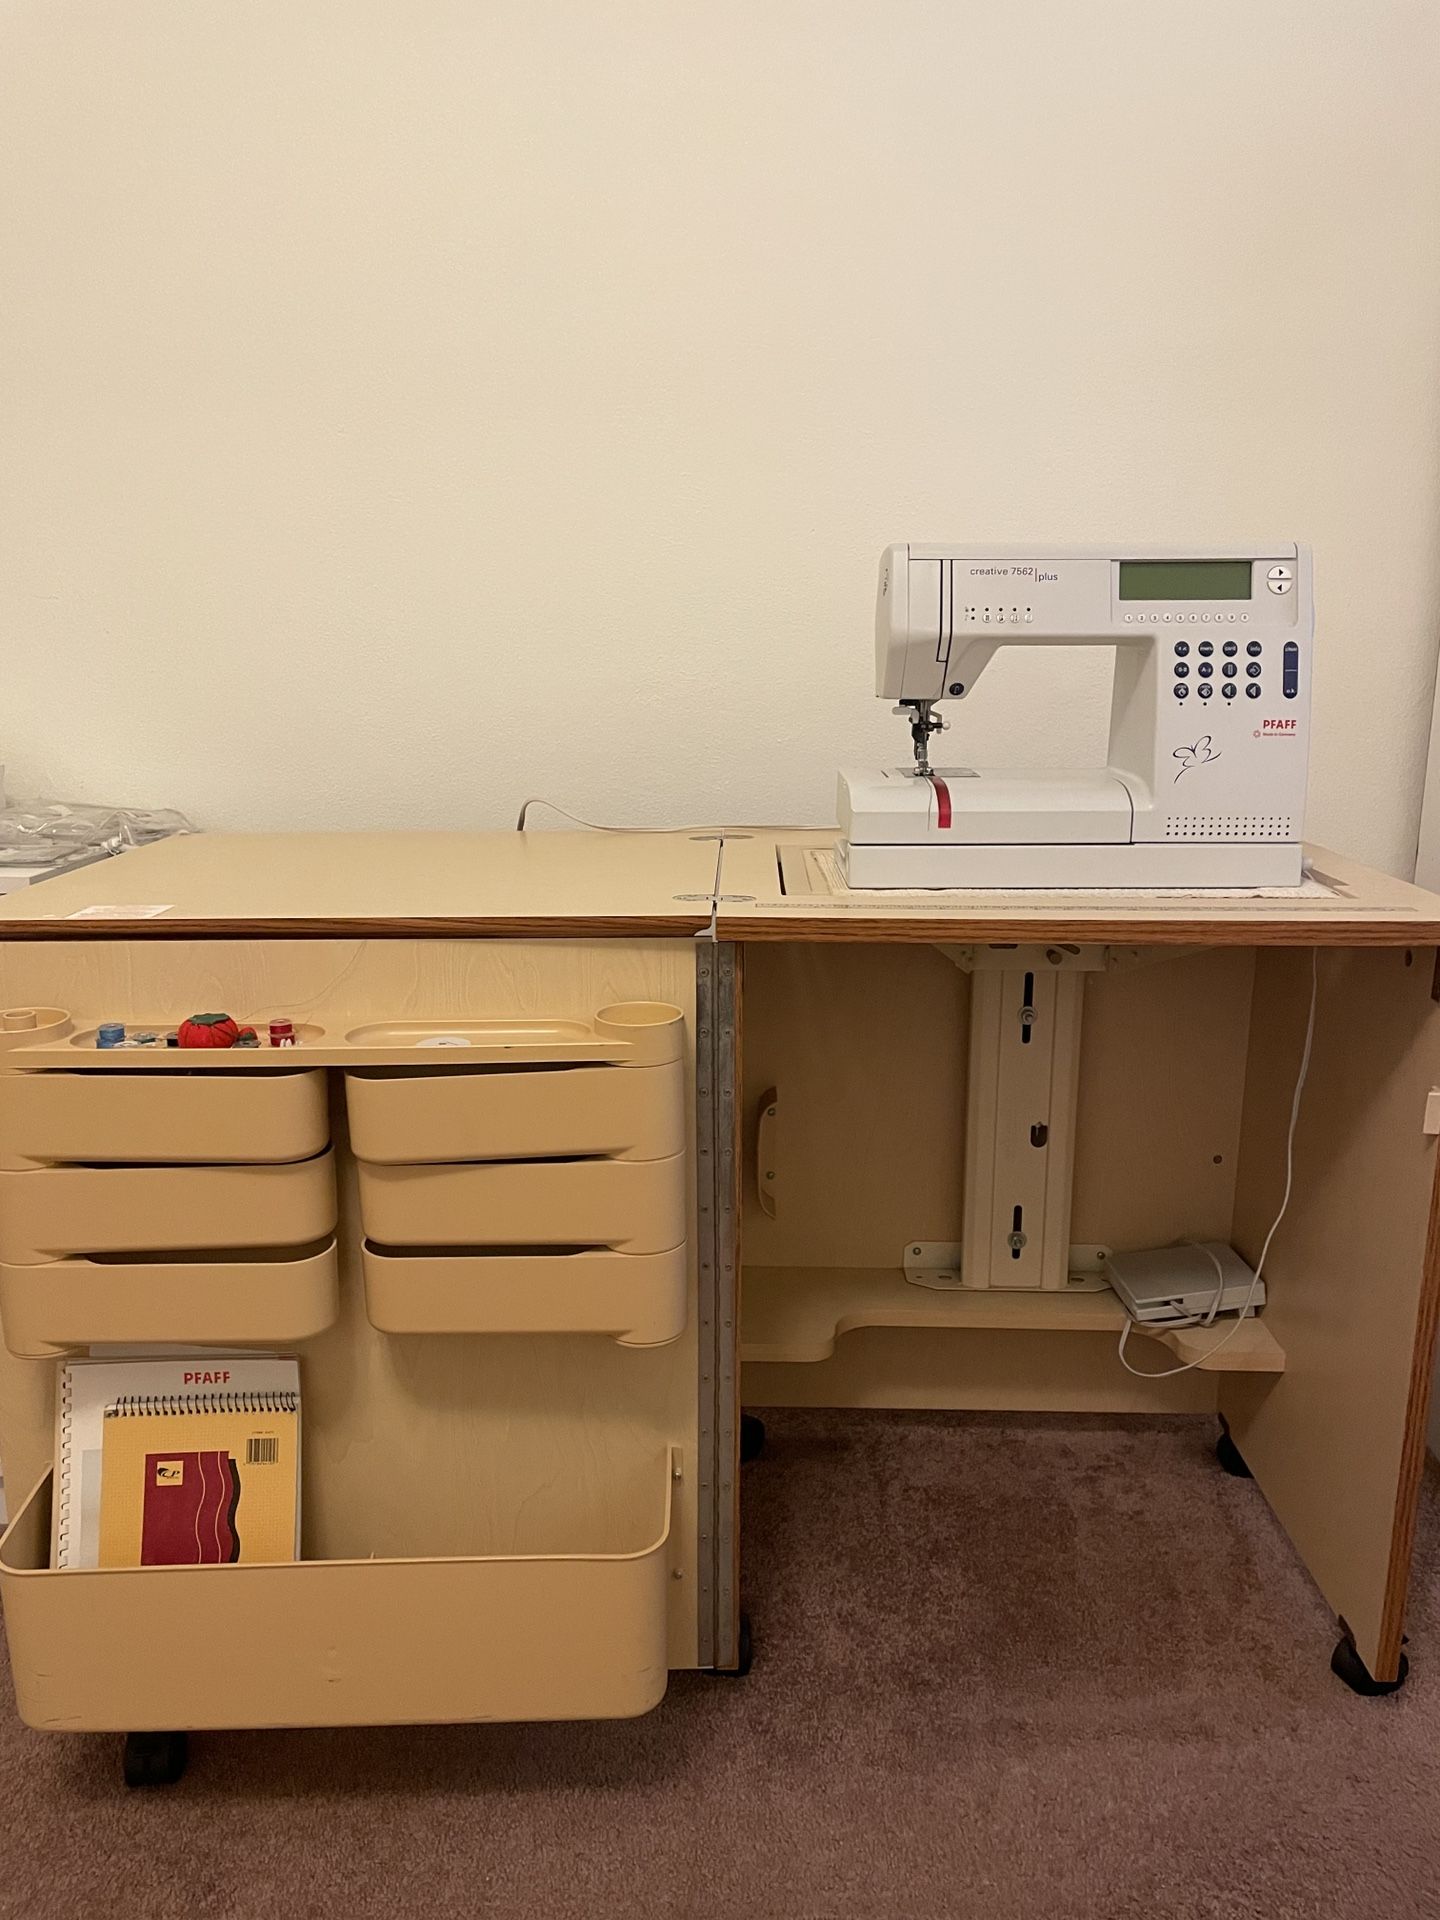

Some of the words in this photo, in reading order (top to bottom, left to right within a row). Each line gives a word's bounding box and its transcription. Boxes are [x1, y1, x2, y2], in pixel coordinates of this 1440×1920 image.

[970, 566, 1008, 576] creative
[1011, 567, 1034, 576] 7562
[1038, 572, 1058, 583] plus
[1263, 719, 1297, 729] PFAFF
[183, 1371, 231, 1385] PFAFF
